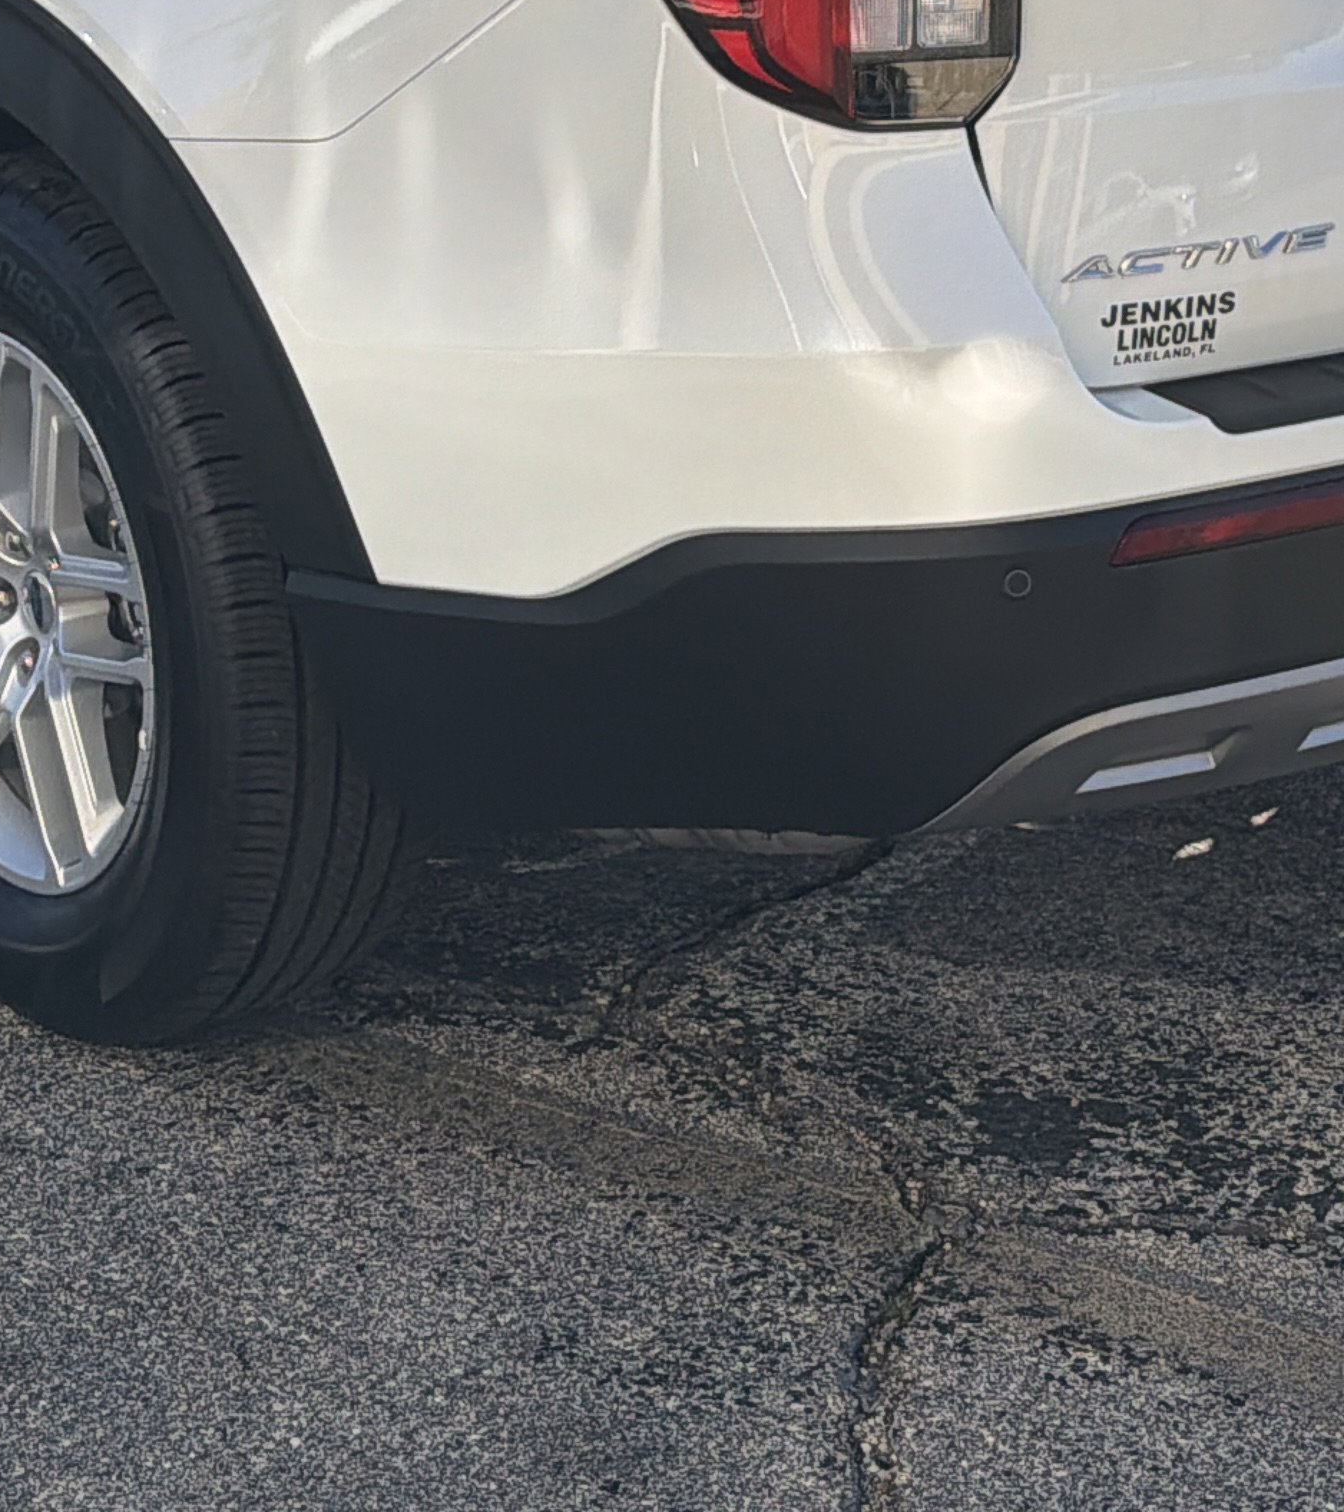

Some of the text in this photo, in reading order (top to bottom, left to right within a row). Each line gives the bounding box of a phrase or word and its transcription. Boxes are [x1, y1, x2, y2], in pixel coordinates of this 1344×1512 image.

[1060, 221, 1336, 284] ACTIVE
[1100, 290, 1237, 328] JENKINS
[1117, 317, 1218, 352] LINCOLN
[1112, 343, 1216, 366] LAKELAND, FL
